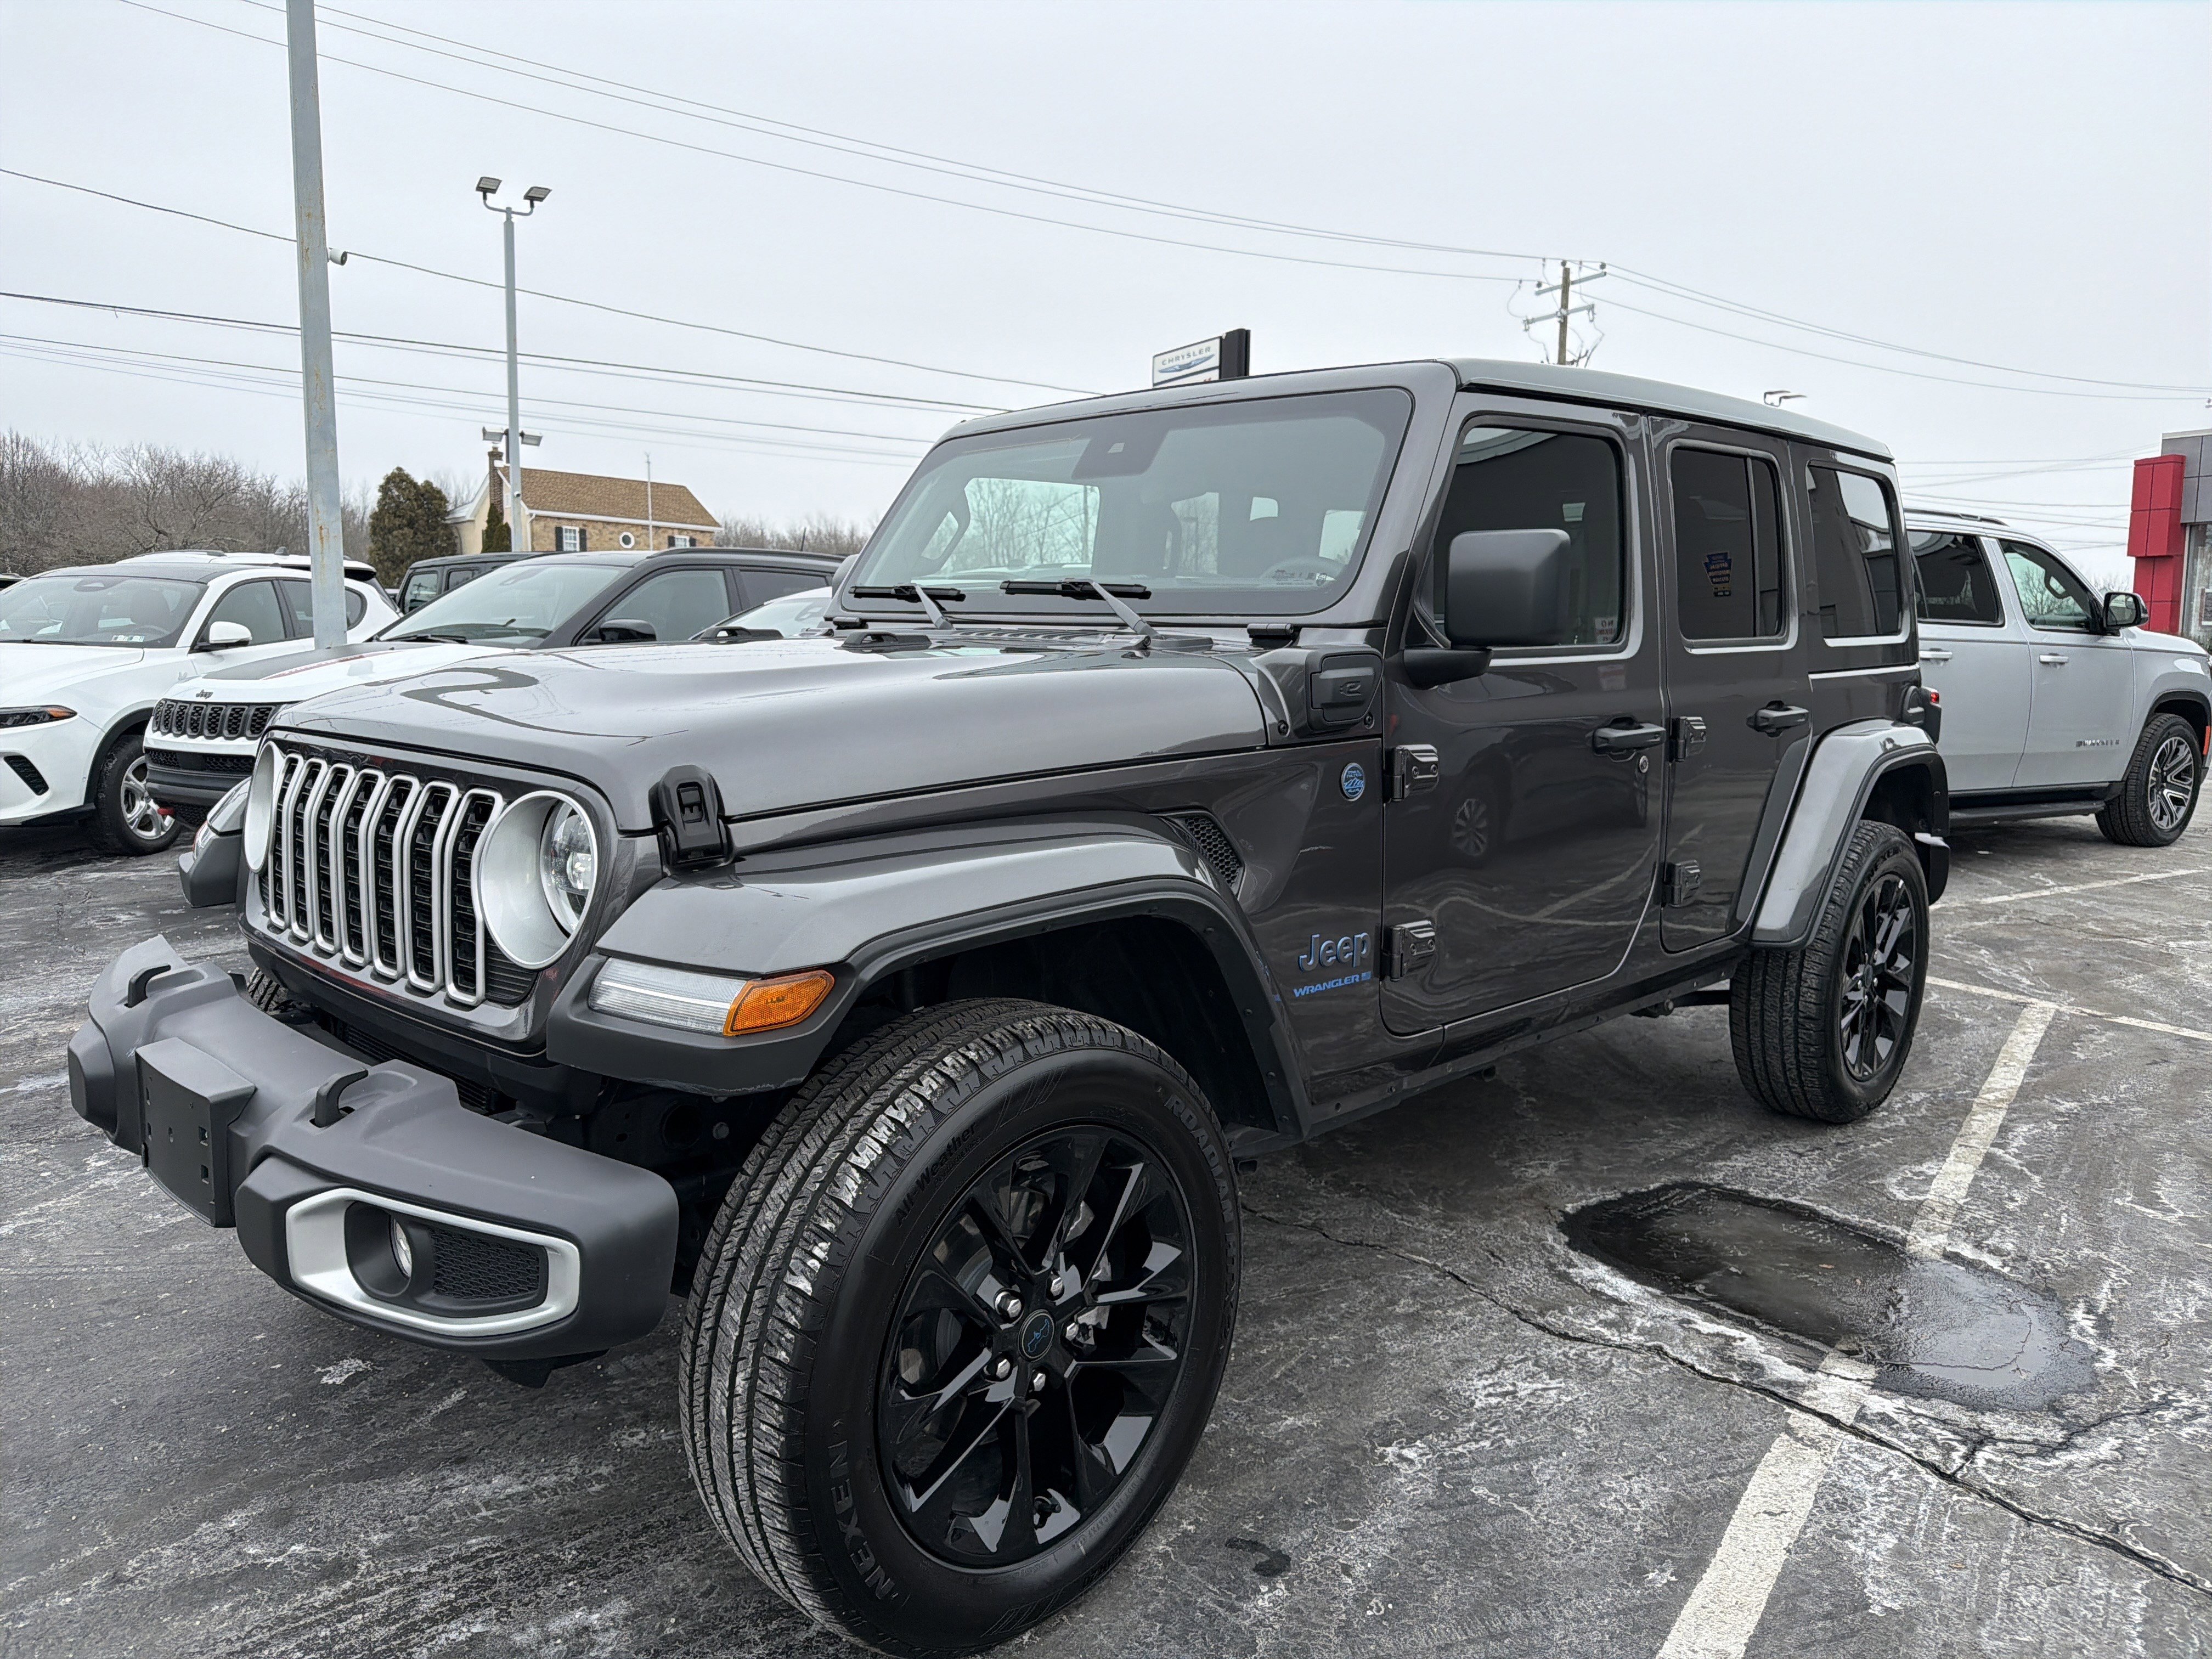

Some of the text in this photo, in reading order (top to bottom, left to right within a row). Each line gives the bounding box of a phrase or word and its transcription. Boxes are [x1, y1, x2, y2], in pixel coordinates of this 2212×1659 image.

[1162, 347, 1211, 365] CHRYSLER
[1293, 974, 1360, 997] WRANGLER
[1298, 932, 1372, 972] Jeep
[895, 1121, 978, 1228] All-Weather
[1164, 1093, 1234, 1223] ROADIAN
[827, 1440, 895, 1600] NEXEN
